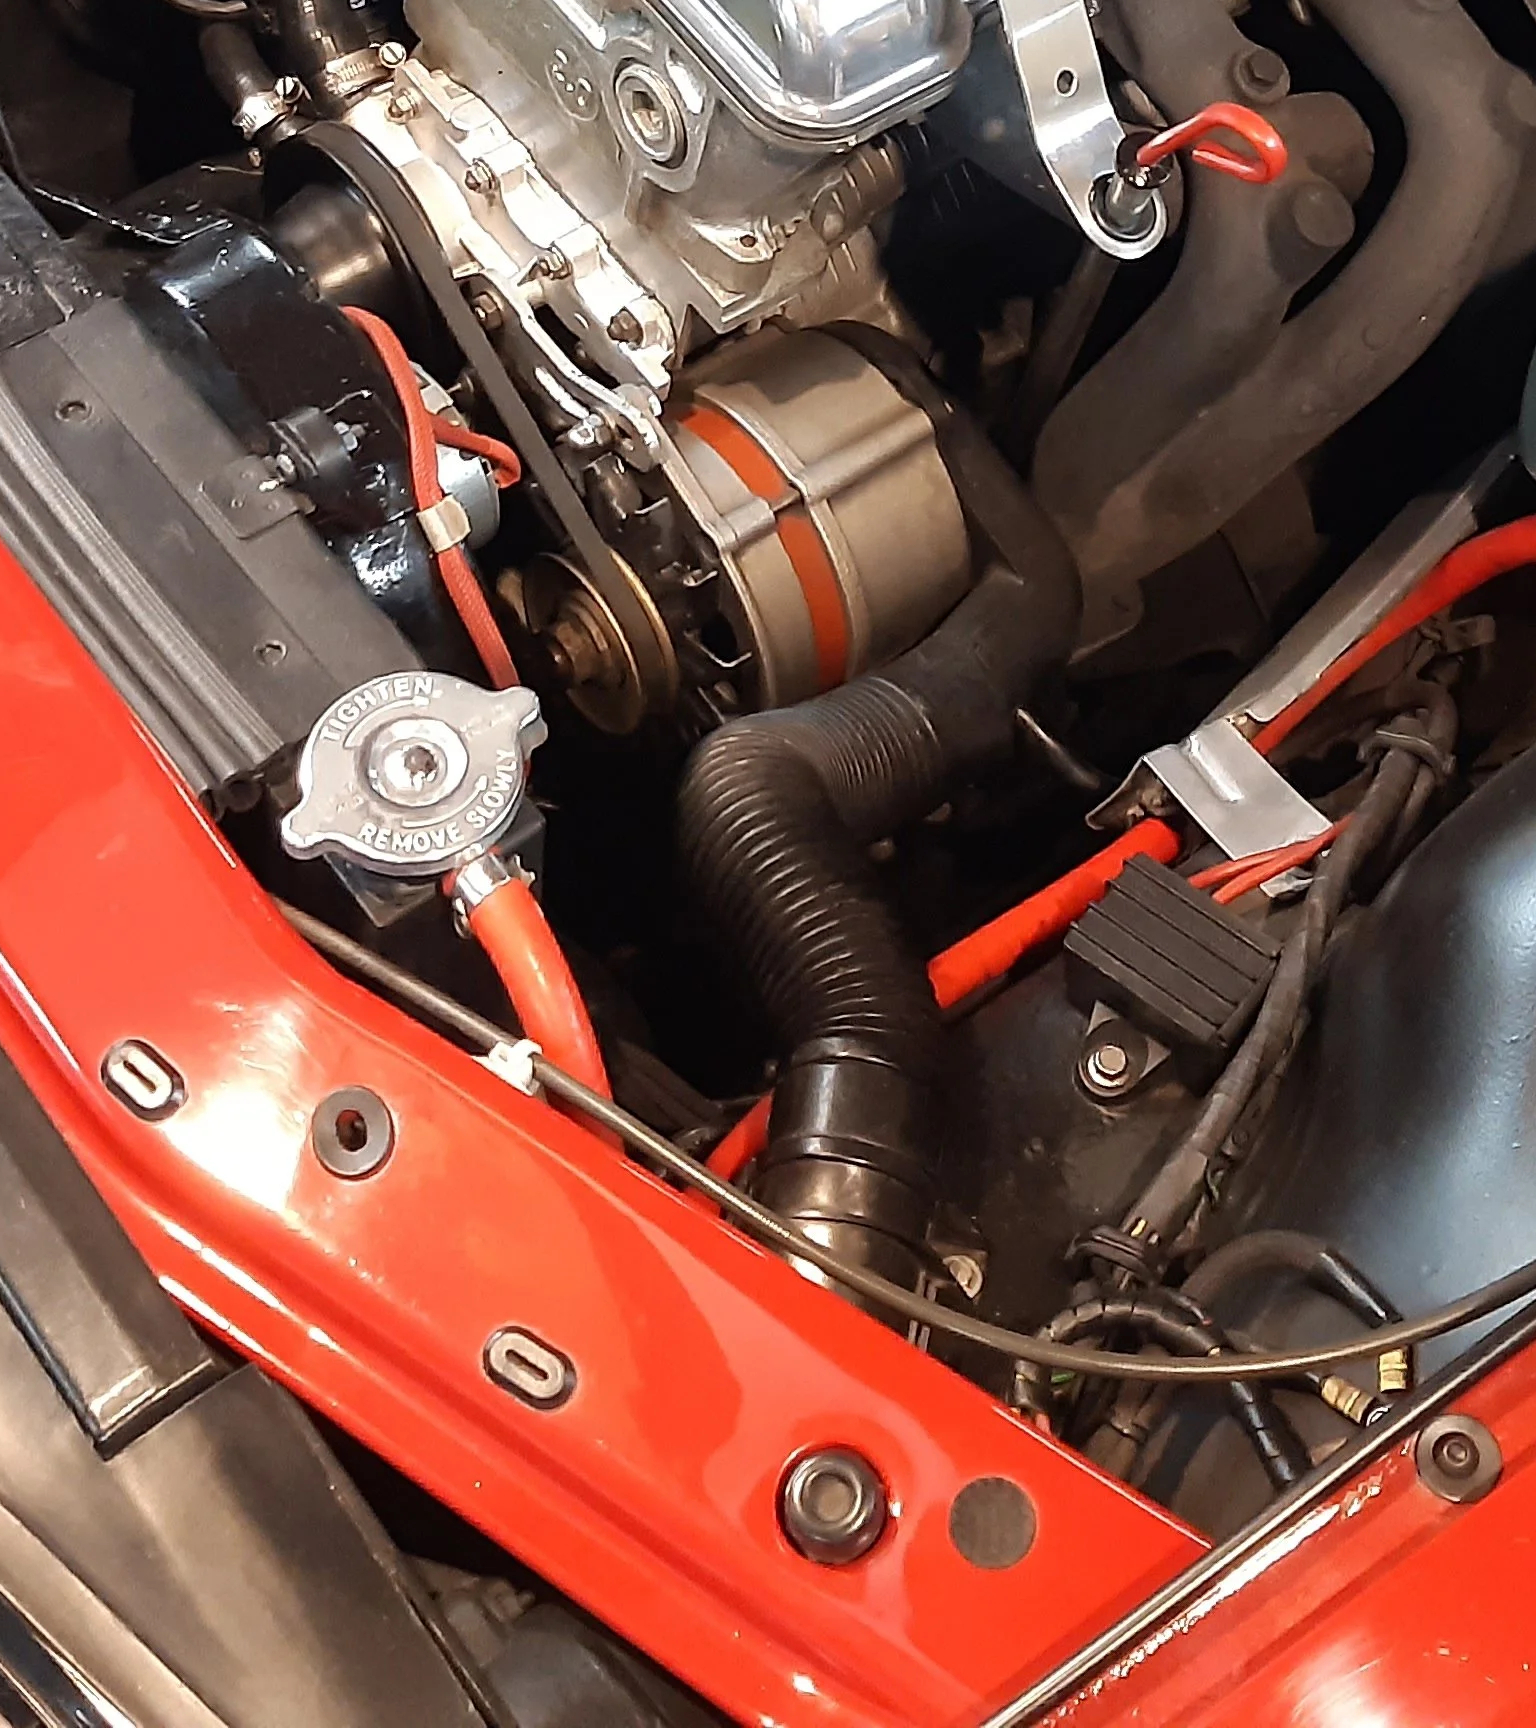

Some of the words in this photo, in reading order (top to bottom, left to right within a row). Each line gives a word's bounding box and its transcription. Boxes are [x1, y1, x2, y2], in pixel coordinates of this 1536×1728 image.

[319, 676, 435, 743] TIGHTEN
[357, 821, 465, 853] REMOVE
[465, 749, 517, 829] SLOWLY
